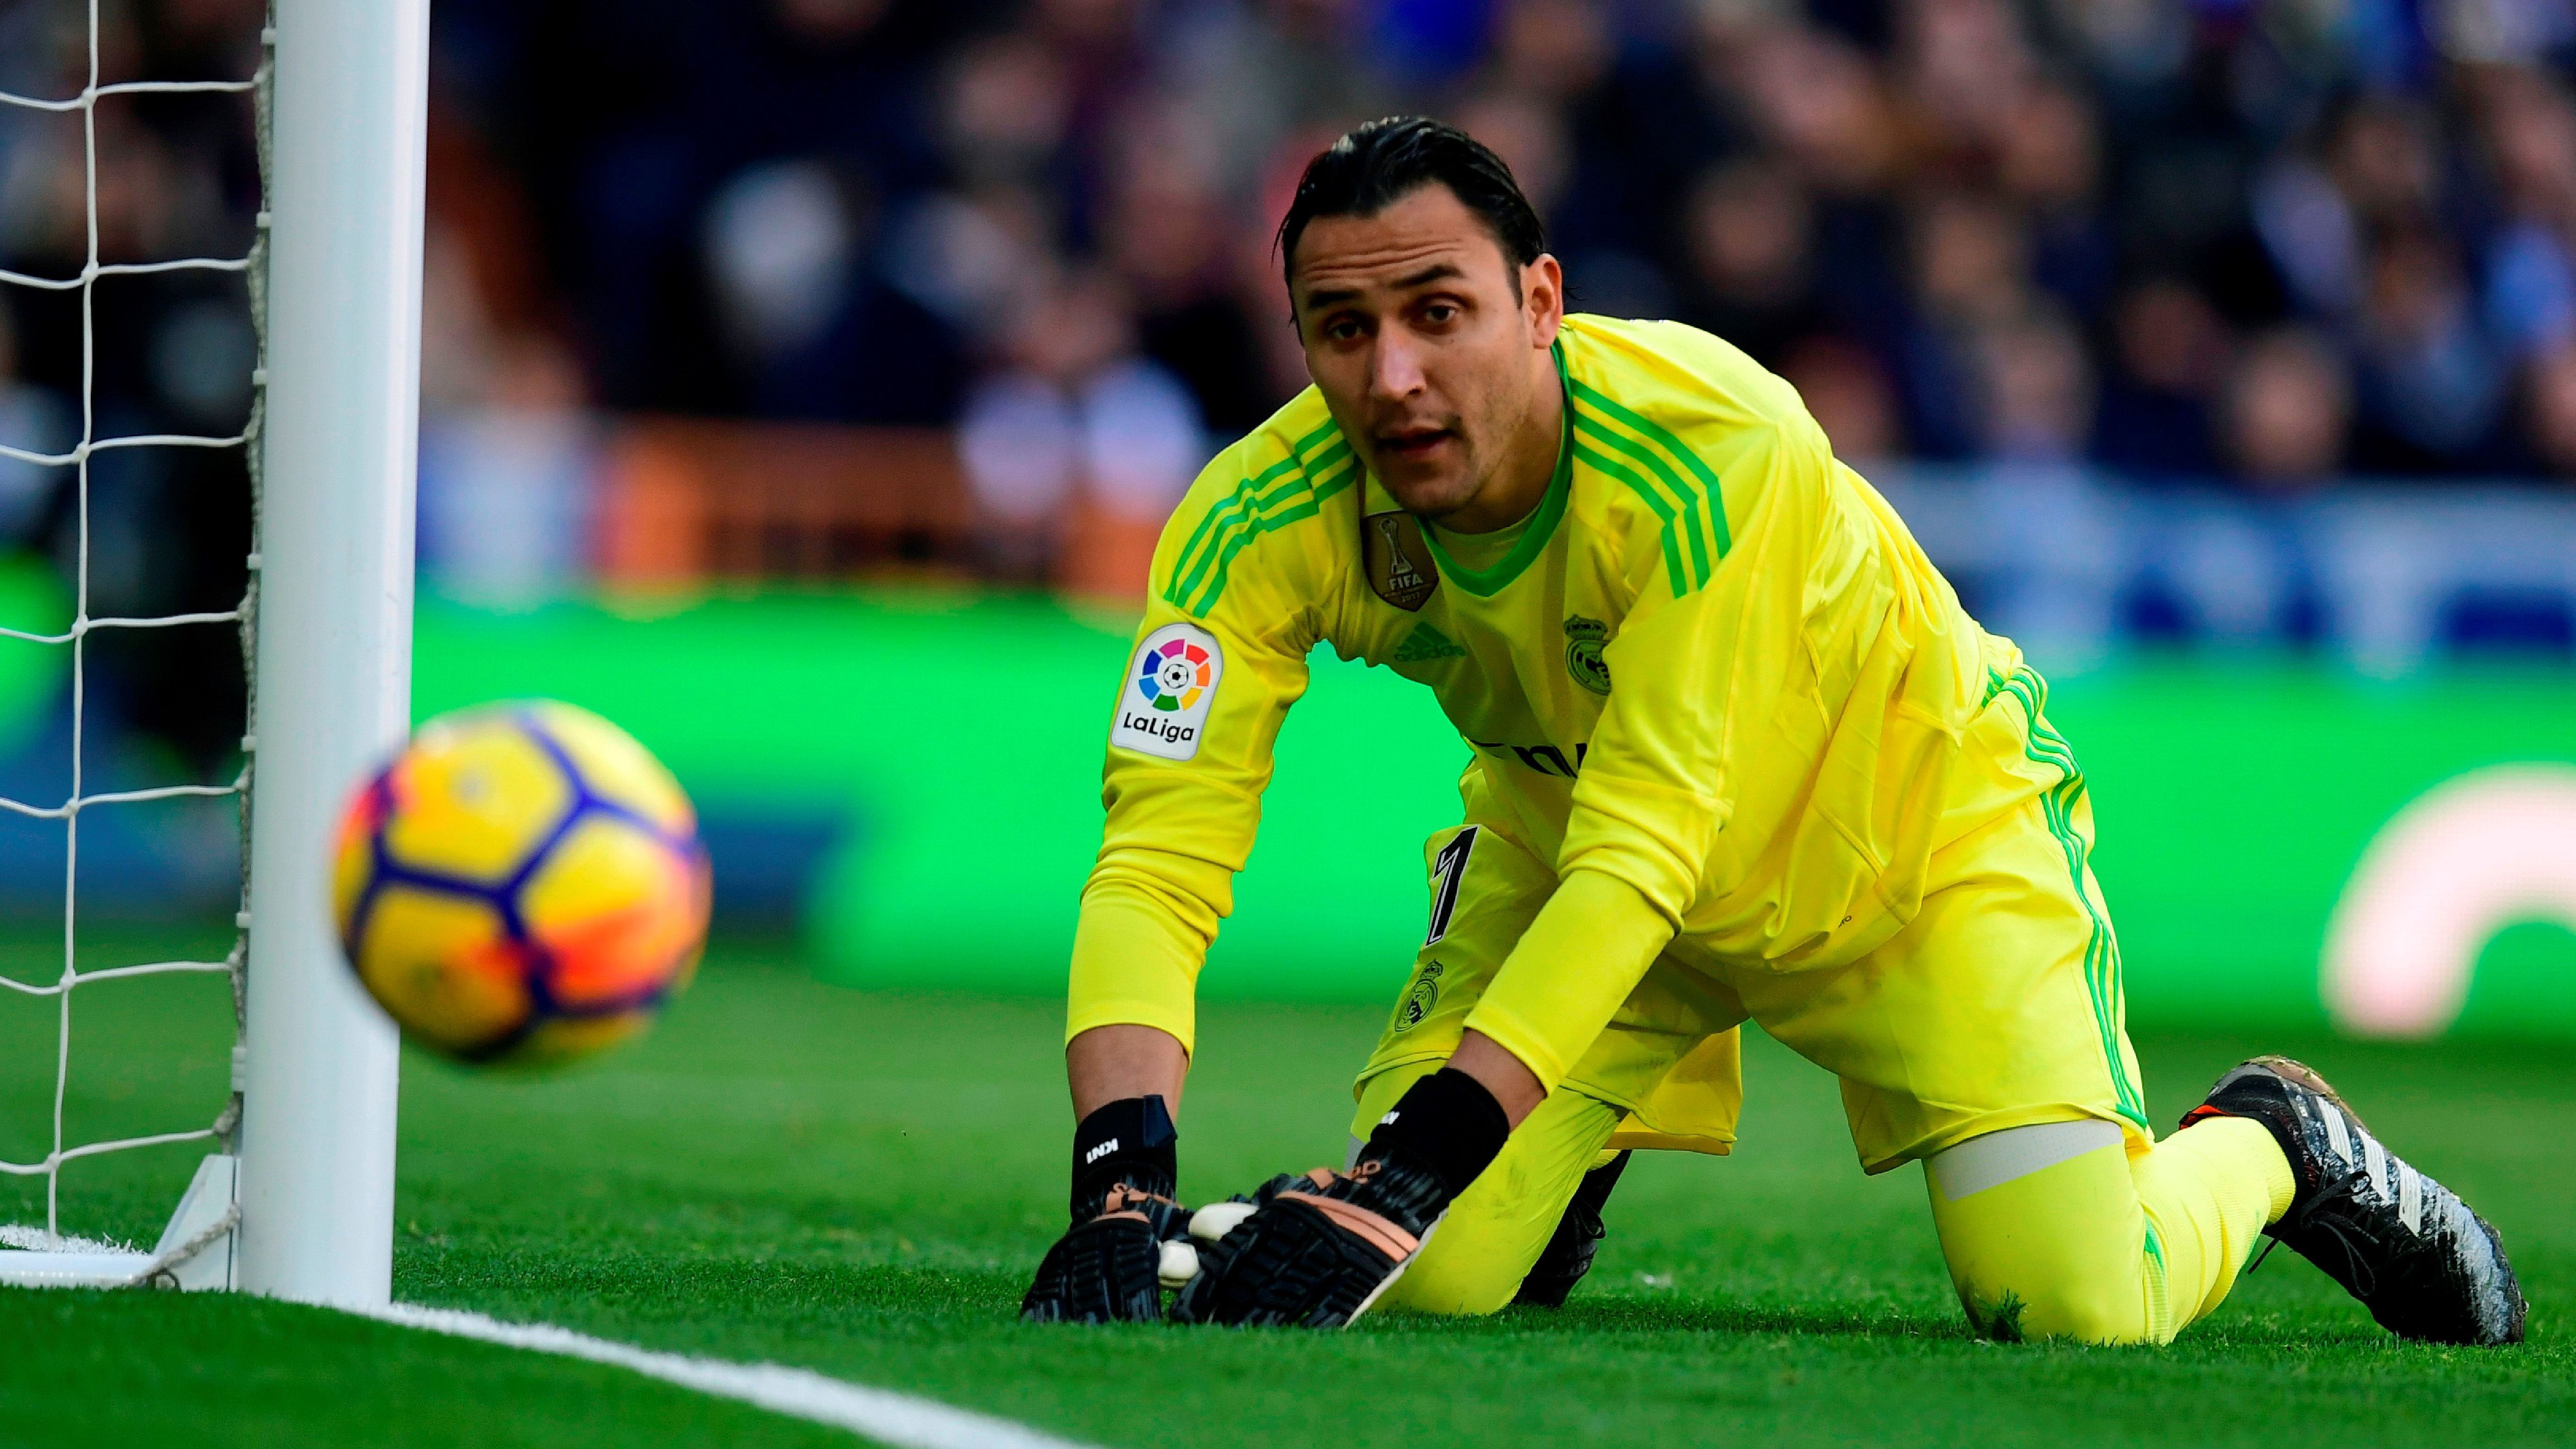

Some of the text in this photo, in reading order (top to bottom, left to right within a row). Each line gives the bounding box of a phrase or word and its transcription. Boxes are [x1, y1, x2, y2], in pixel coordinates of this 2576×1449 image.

[1388, 573, 1424, 590] FIFA
[1123, 712, 1194, 742] LaLiga
[1425, 825, 1479, 947] 1
